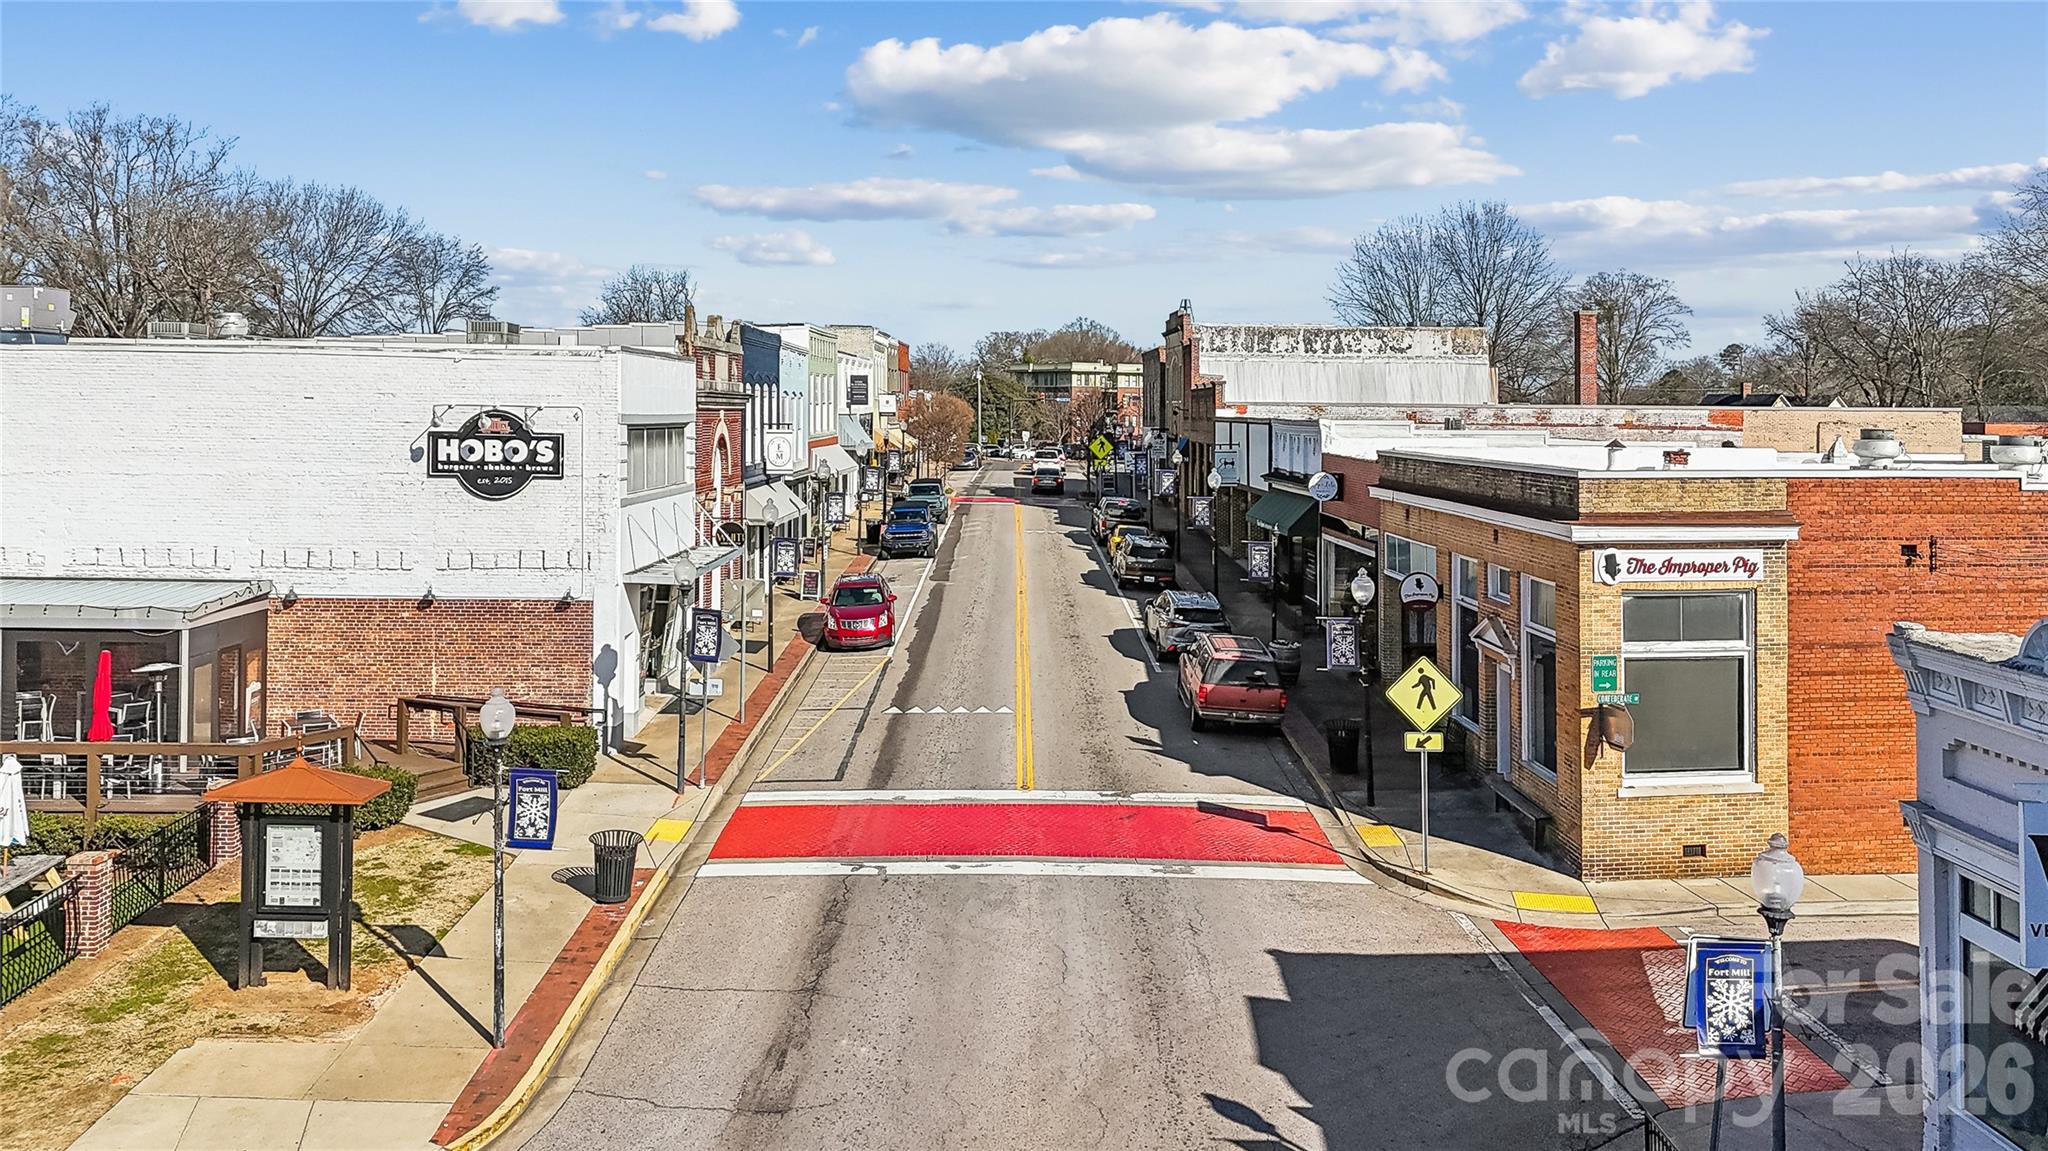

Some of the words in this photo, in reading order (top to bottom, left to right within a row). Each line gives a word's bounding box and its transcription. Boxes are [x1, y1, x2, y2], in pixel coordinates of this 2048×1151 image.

[437, 438, 555, 463] HOBO'S
[437, 463, 474, 472] burgers
[493, 476, 513, 484] 2015
[1626, 557, 1657, 575] The
[1658, 557, 1731, 578] Improper
[1732, 556, 1760, 579] Pig
[1598, 695, 1632, 704] CONFEDERATE
[1714, 957, 1739, 965] WELCOME
[1708, 968, 1729, 976] Fort
[1731, 968, 1751, 977] Mill
